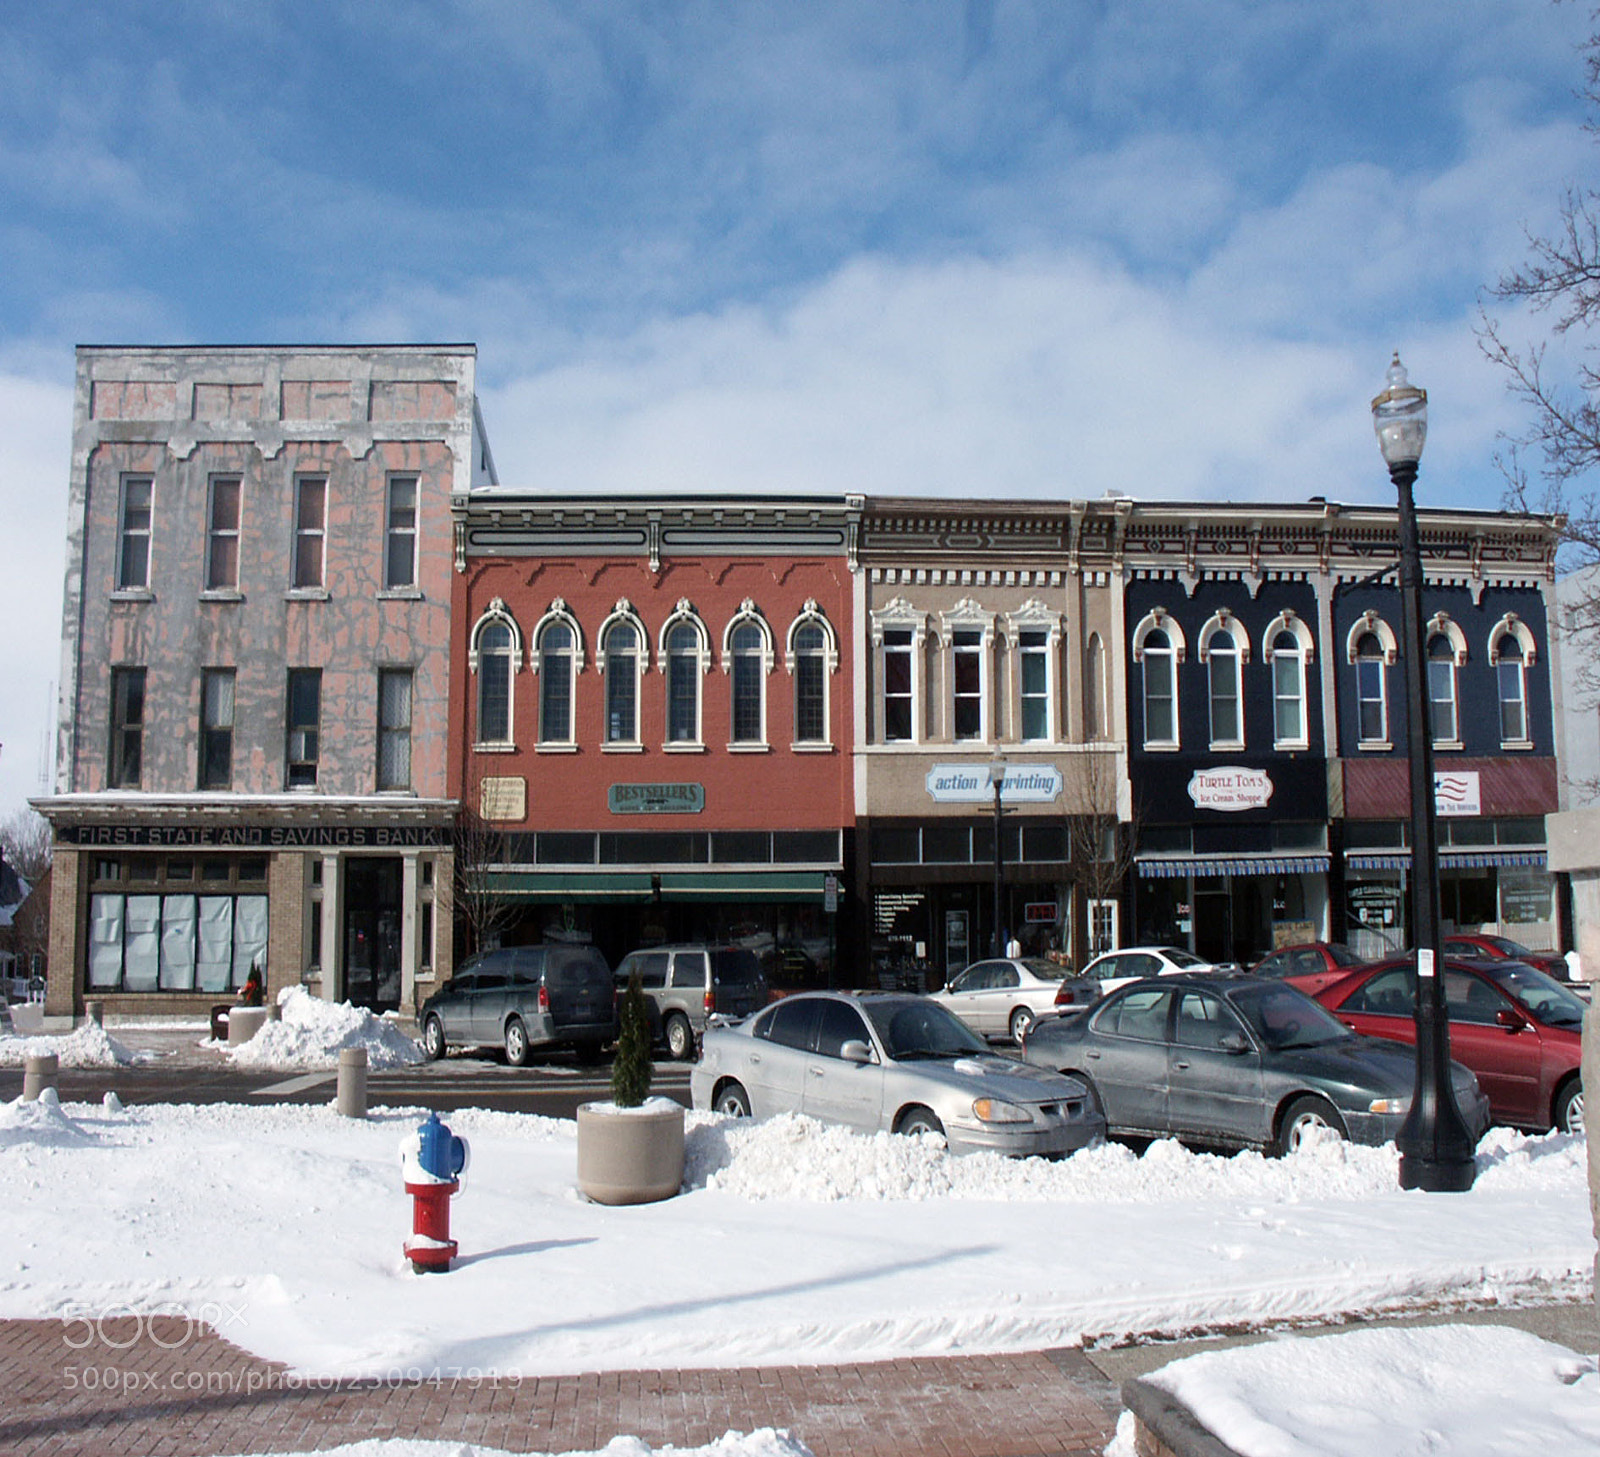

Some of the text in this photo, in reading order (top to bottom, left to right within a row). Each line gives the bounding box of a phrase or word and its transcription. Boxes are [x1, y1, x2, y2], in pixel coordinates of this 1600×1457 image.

[935, 774, 978, 790] action
[1198, 774, 1233, 789] TURTLE
[615, 785, 697, 803] BESTSELLERS
[78, 827, 437, 846] FIRST STATE AND SAVINGS BANK
[1027, 905, 1057, 920] OPEN
